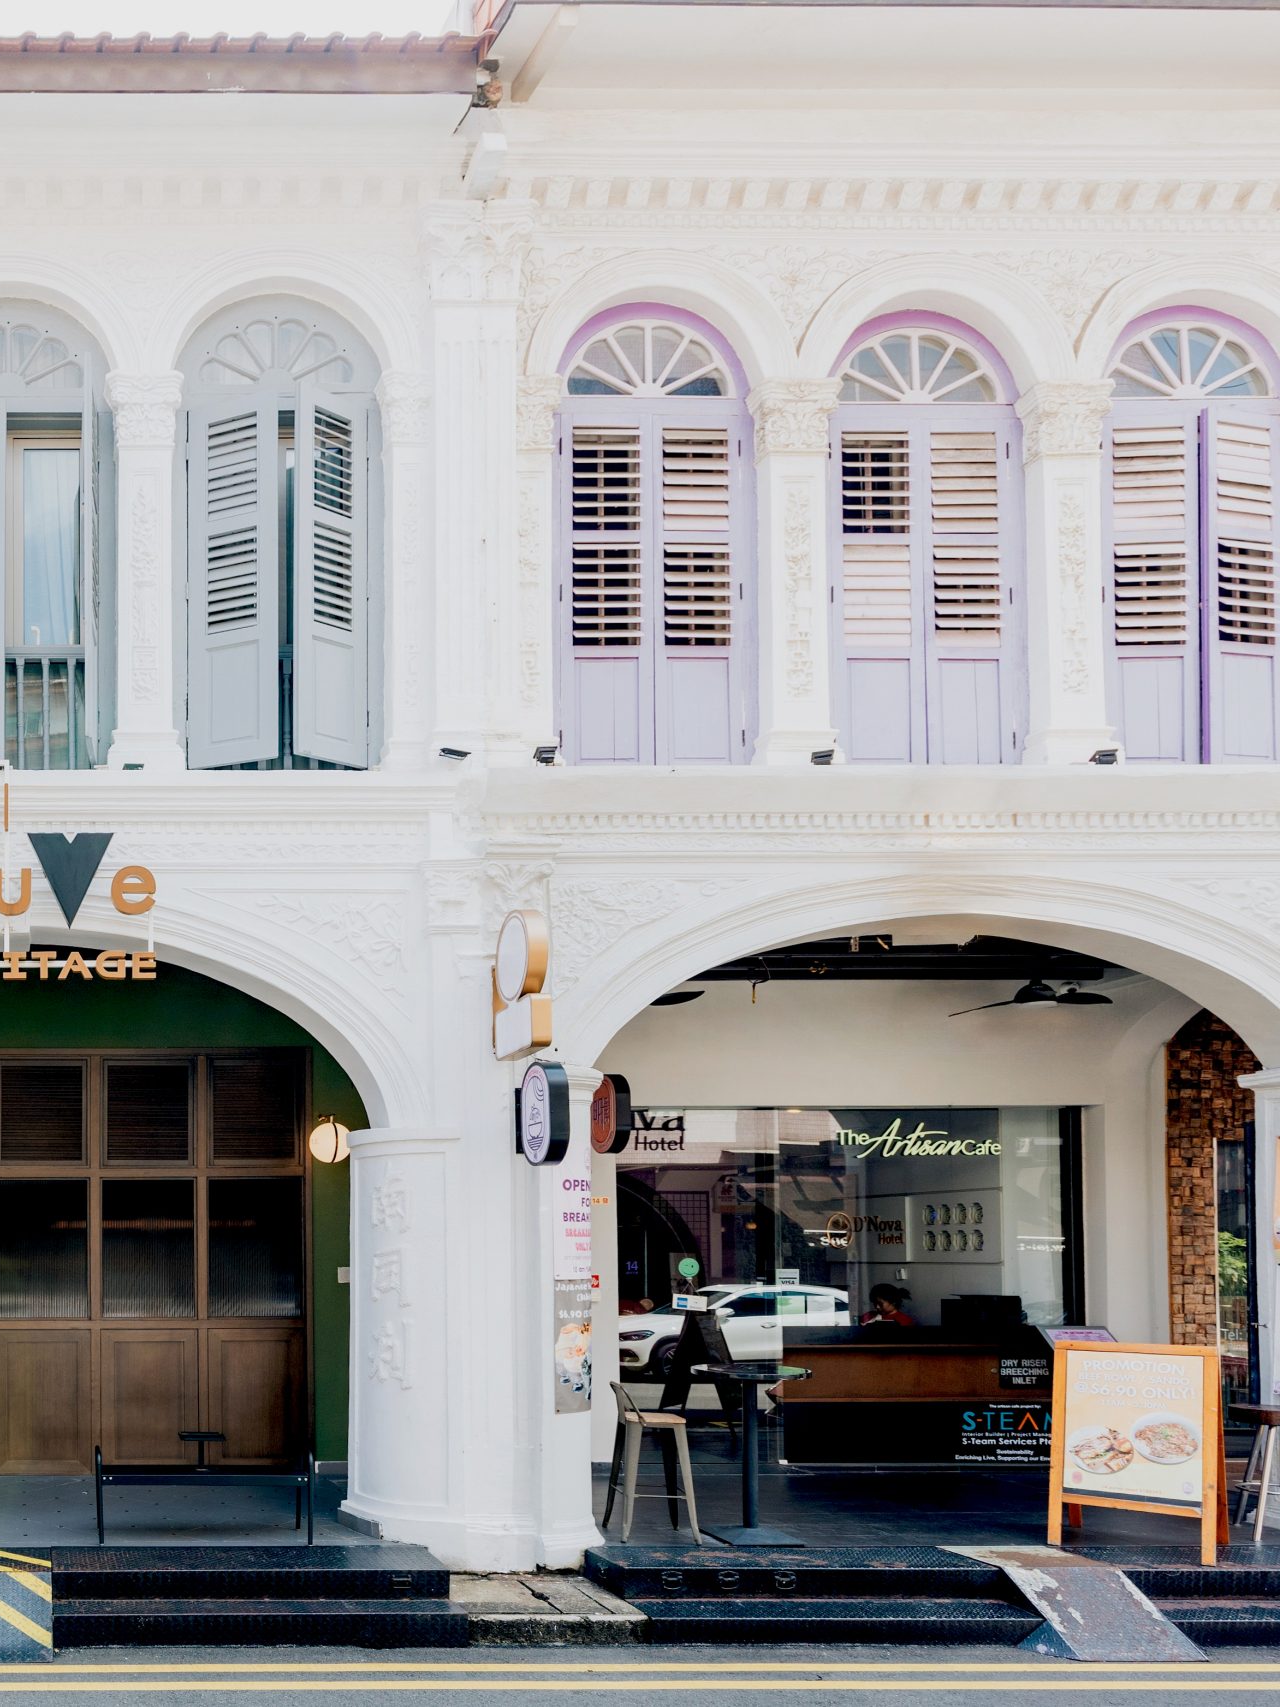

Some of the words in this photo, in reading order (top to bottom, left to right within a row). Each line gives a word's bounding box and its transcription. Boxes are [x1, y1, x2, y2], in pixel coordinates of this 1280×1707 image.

[634, 1135, 685, 1151] Hotel
[836, 1129, 870, 1146] The
[857, 1118, 966, 1159] Artisan
[961, 1140, 1002, 1155] Cafe
[853, 1215, 903, 1233] D'Nova
[878, 1233, 904, 1245] Hotel
[625, 1261, 639, 1271] 14
[1220, 1328, 1243, 1340] Tel:
[1001, 1359, 1019, 1367] DRY
[1021, 1359, 1047, 1367] RISER
[1083, 1360, 1185, 1376] PROMOTION
[1000, 1368, 1049, 1376] BREECHING
[1012, 1376, 1037, 1384] INLET
[962, 1437, 997, 1445] S-Team
[999, 1437, 1037, 1445] Services
